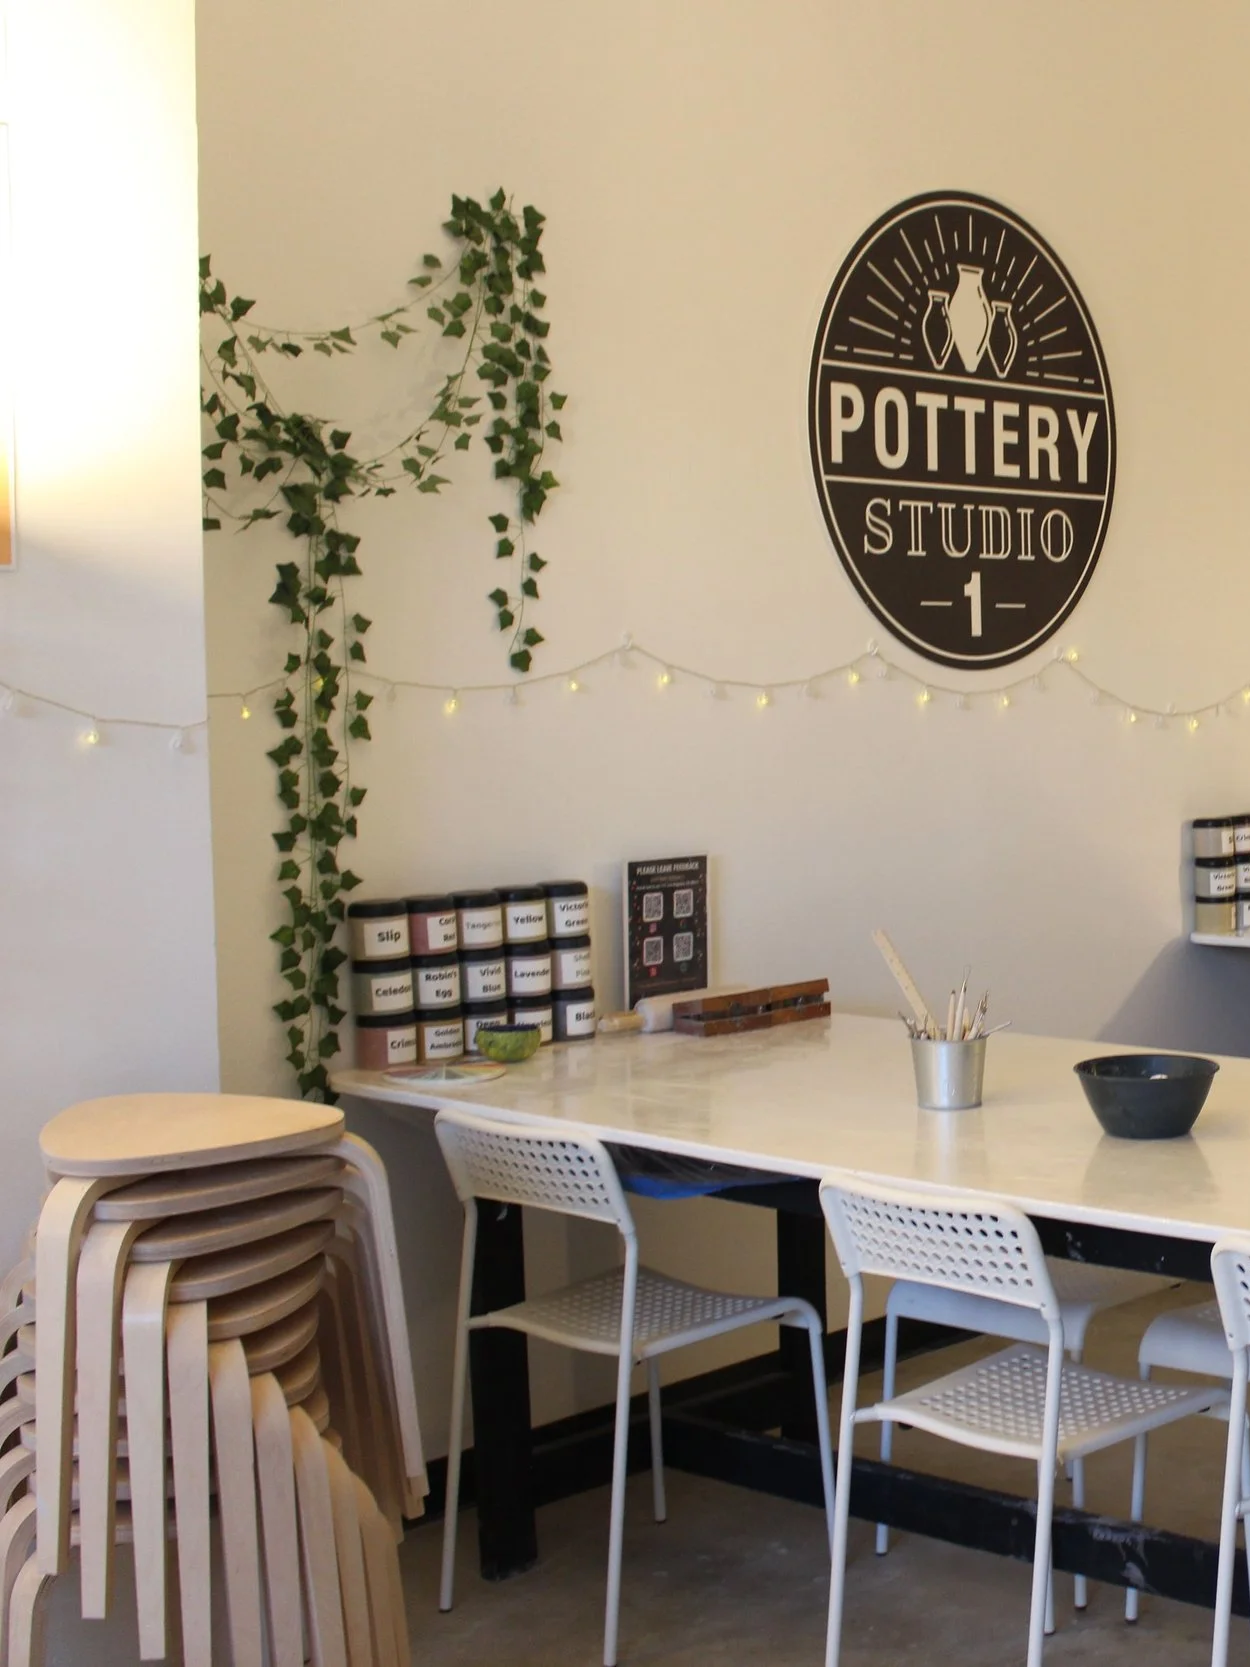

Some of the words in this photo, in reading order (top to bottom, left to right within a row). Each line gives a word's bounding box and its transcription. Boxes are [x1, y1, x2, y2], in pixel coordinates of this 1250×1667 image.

[830, 380, 1099, 483] POTTERY
[863, 498, 1074, 563] STUDIO
[963, 571, 982, 637] 1
[636, 865, 656, 876] PLEASE
[656, 863, 673, 874] LEAVE
[513, 914, 544, 925] Yellow
[377, 929, 402, 943] Slip
[424, 970, 458, 982] Robin's
[479, 966, 502, 977] Vivid
[435, 989, 453, 999] Egg
[482, 984, 502, 993] Blue
